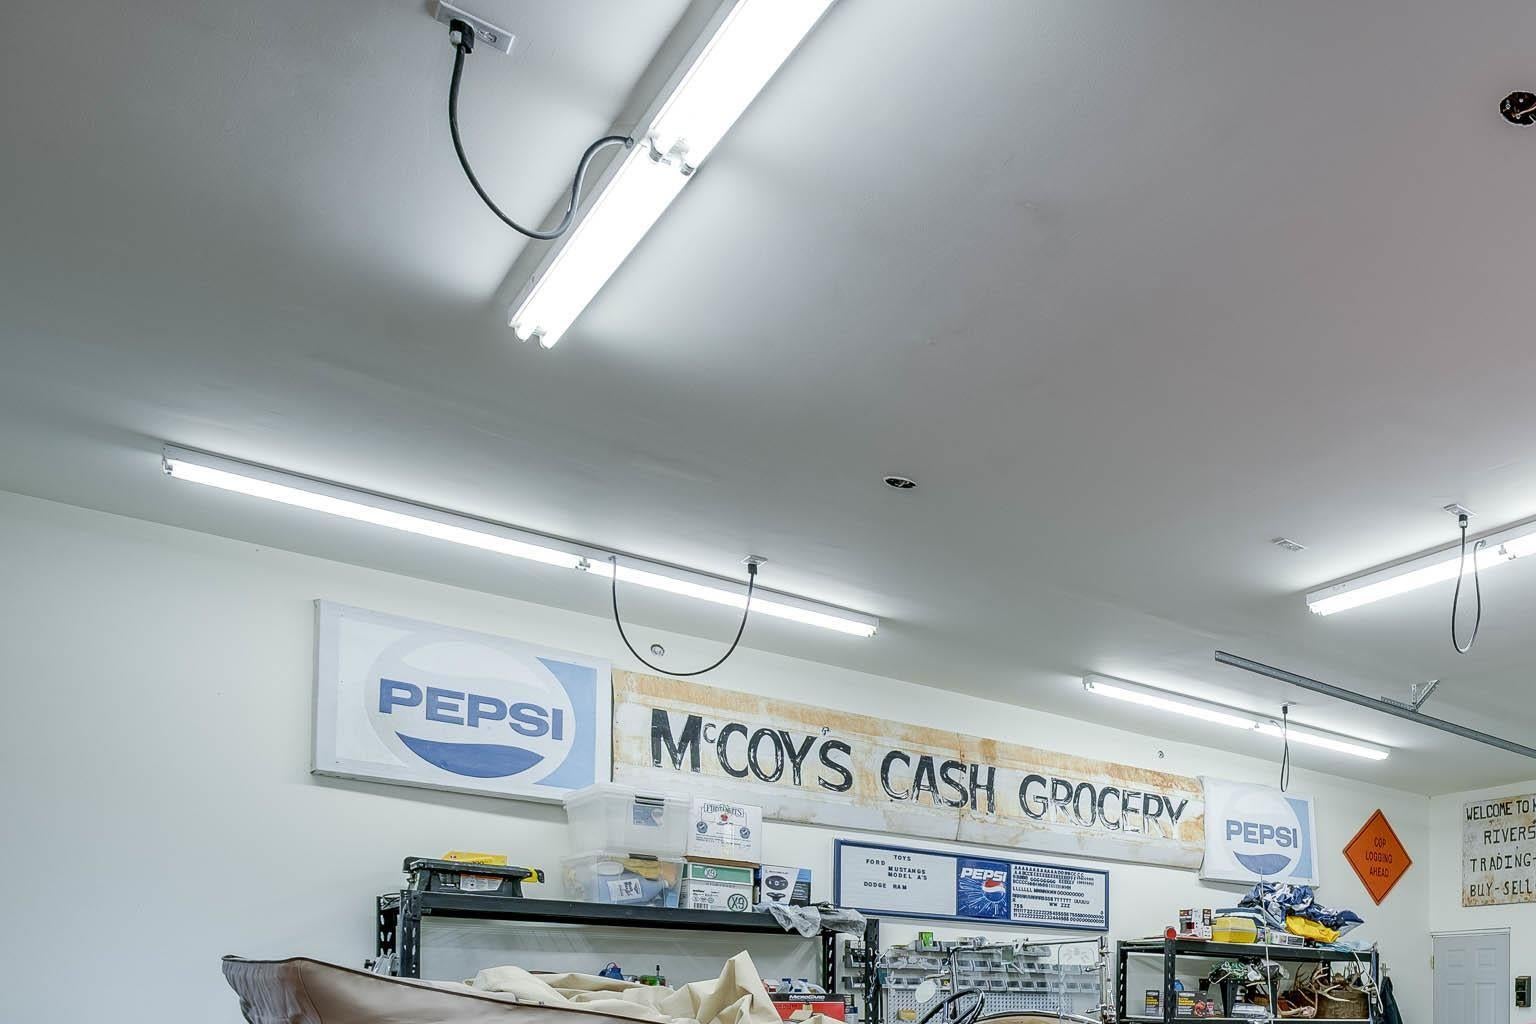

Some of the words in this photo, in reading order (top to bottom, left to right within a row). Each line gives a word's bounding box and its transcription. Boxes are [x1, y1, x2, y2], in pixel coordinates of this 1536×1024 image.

[379, 677, 564, 741] PEPSI
[880, 749, 996, 815] CASH
[1019, 773, 1188, 839] GROCERY
[1466, 800, 1513, 821] WELCOME
[1516, 798, 1530, 813] TO
[1226, 818, 1298, 849] PEPSI
[1365, 850, 1393, 864] LOGGING
[888, 866, 926, 875] MUSTANGS
[961, 867, 1007, 882] PEPSI
[1369, 866, 1389, 878] AHEAD
[863, 881, 887, 889] DODGE
